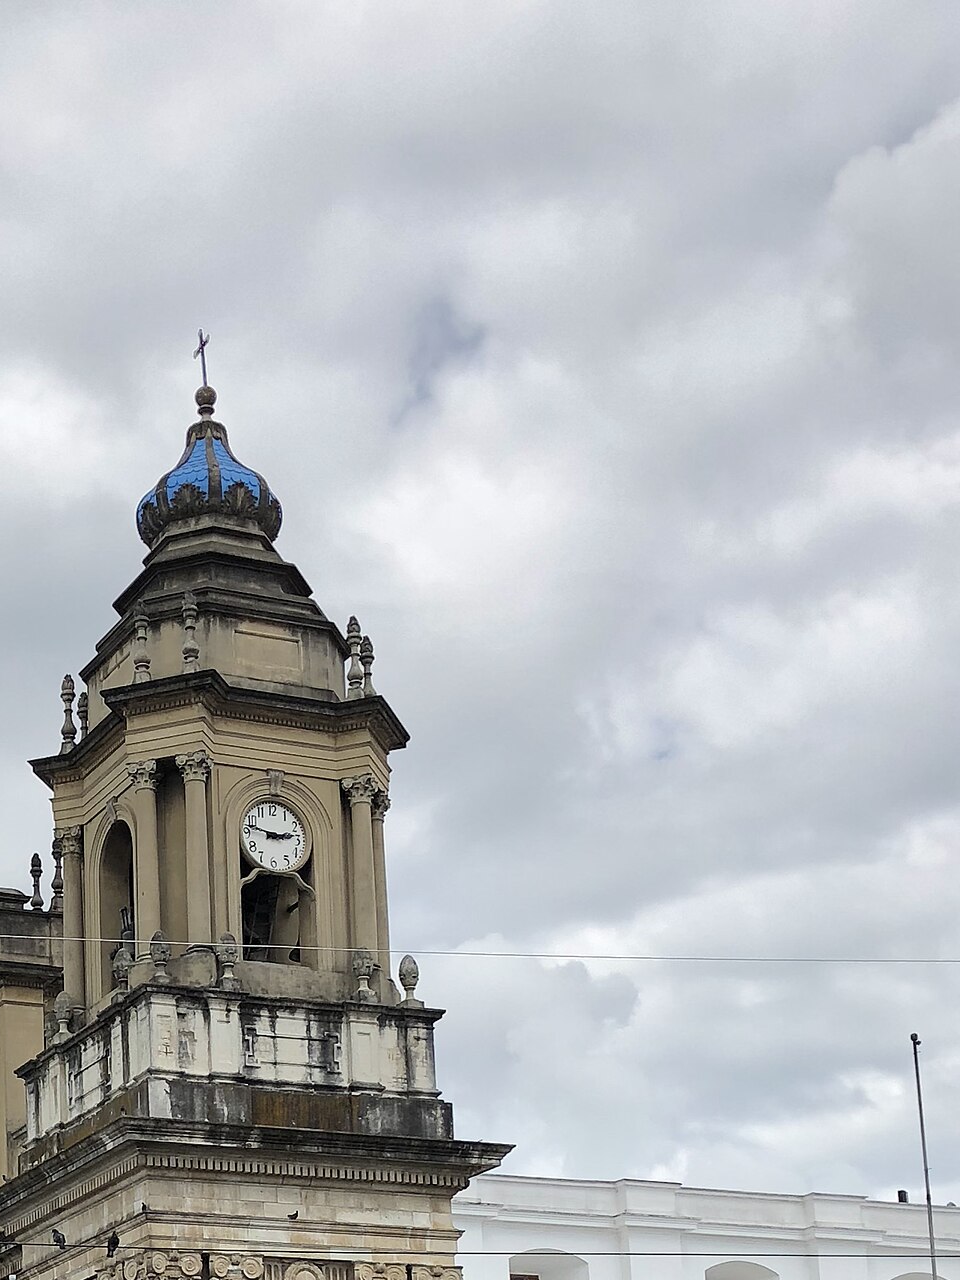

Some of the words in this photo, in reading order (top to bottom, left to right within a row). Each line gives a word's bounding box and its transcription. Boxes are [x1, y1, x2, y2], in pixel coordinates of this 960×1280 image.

[257, 806, 264, 818] 11
[268, 804, 277, 817] 12
[243, 827, 251, 839] 9
[292, 821, 298, 833] 2
[248, 840, 257, 853] 8
[258, 851, 264, 863] 7
[270, 857, 278, 869] 6
[283, 855, 290, 866] 5
